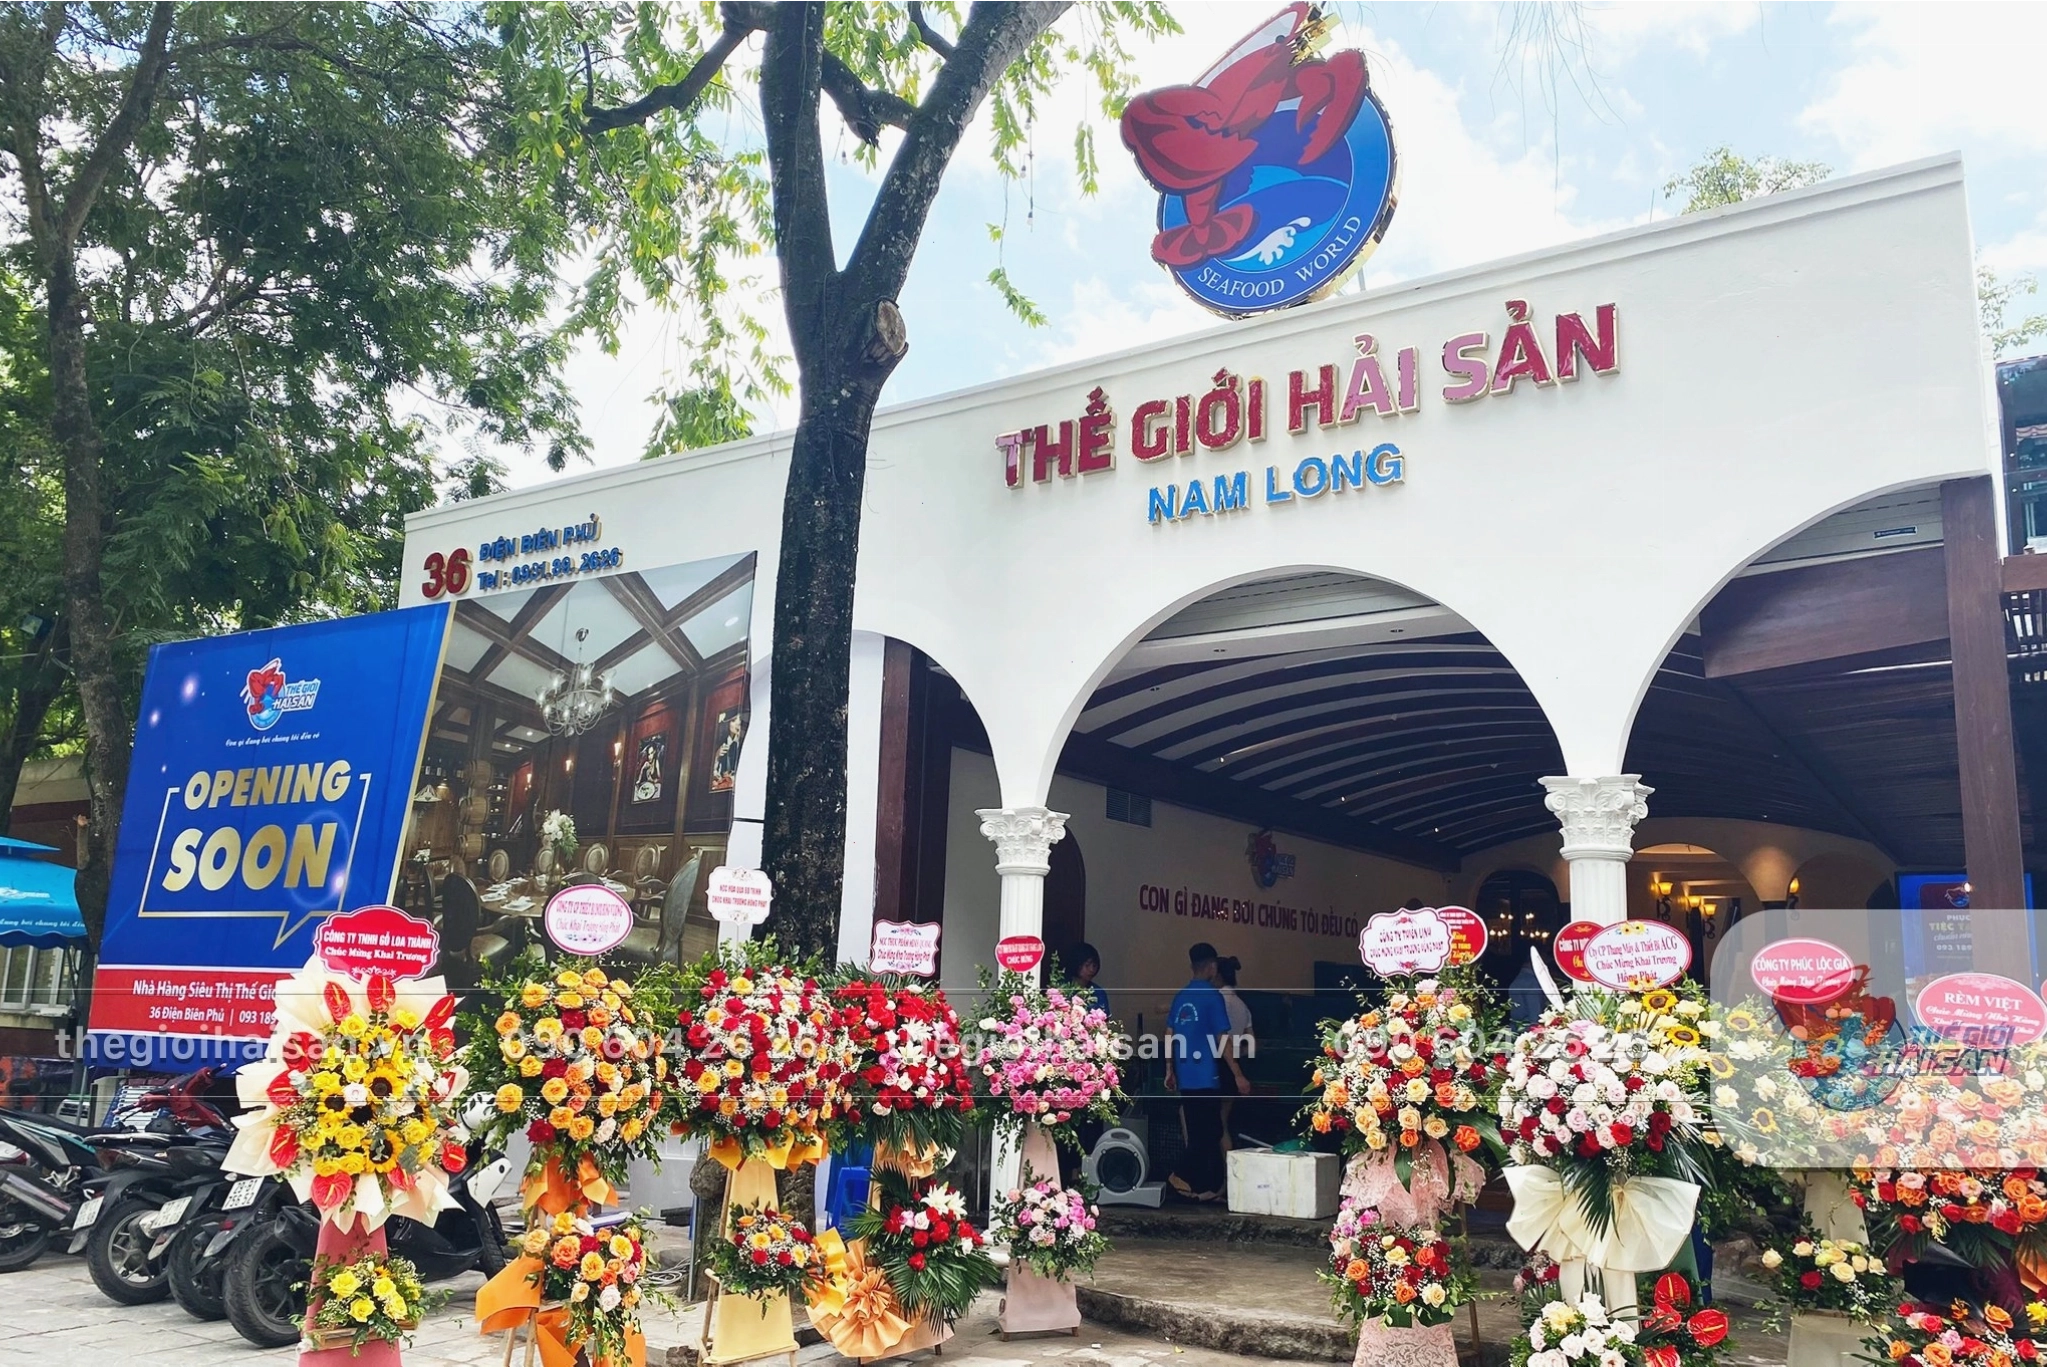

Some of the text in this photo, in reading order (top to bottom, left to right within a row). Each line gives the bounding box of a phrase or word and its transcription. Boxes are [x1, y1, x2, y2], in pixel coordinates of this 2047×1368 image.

[1198, 216, 1361, 298] SEAFOOD WORLD
[995, 300, 1620, 489] THẾ GIỚI HẢI SẢN
[1148, 443, 1405, 525] NAM LONG
[479, 513, 602, 562] ĐIỆN BIÊN PHỦ
[422, 548, 473, 599] 36
[184, 760, 351, 810] OPENING
[161, 822, 338, 892] SOON
[1140, 884, 1170, 914] CON
[1174, 886, 1188, 916] GÌ
[1192, 892, 1228, 922] ĐANG
[1258, 900, 1298, 931] CHÚNG
[1300, 906, 1318, 934] TÔI
[1321, 905, 1342, 936] ĐỀU
[1344, 912, 1358, 938] CÓ
[324, 930, 346, 943] CÔNG
[348, 932, 356, 944] TY
[325, 946, 348, 956] Chúc
[348, 947, 372, 960] Mừng
[374, 950, 394, 960] Khai
[1598, 945, 1606, 957] CP
[1635, 943, 1640, 952] &
[1660, 936, 1678, 950] ACG
[1596, 959, 1613, 970] Chúc
[1614, 958, 1634, 969] Mừng
[1635, 956, 1651, 966] Khai
[1755, 956, 1779, 971] CÔNG
[1779, 958, 1789, 971] TY
[1791, 956, 1814, 971] PHÚC
[1816, 956, 1833, 973] LỘC
[133, 980, 154, 996] Nhà
[156, 980, 186, 1001] Hàng
[188, 980, 212, 999] Siêu
[215, 983, 233, 1003] Thị
[235, 981, 258, 1000] Thế
[1944, 990, 2023, 1012] RÈM VIỆT
[149, 1006, 160, 1018] 36
[162, 1007, 182, 1022] Điện
[184, 1008, 204, 1020] Biên
[206, 1008, 224, 1022] Phủ
[238, 1010, 257, 1023] 093
